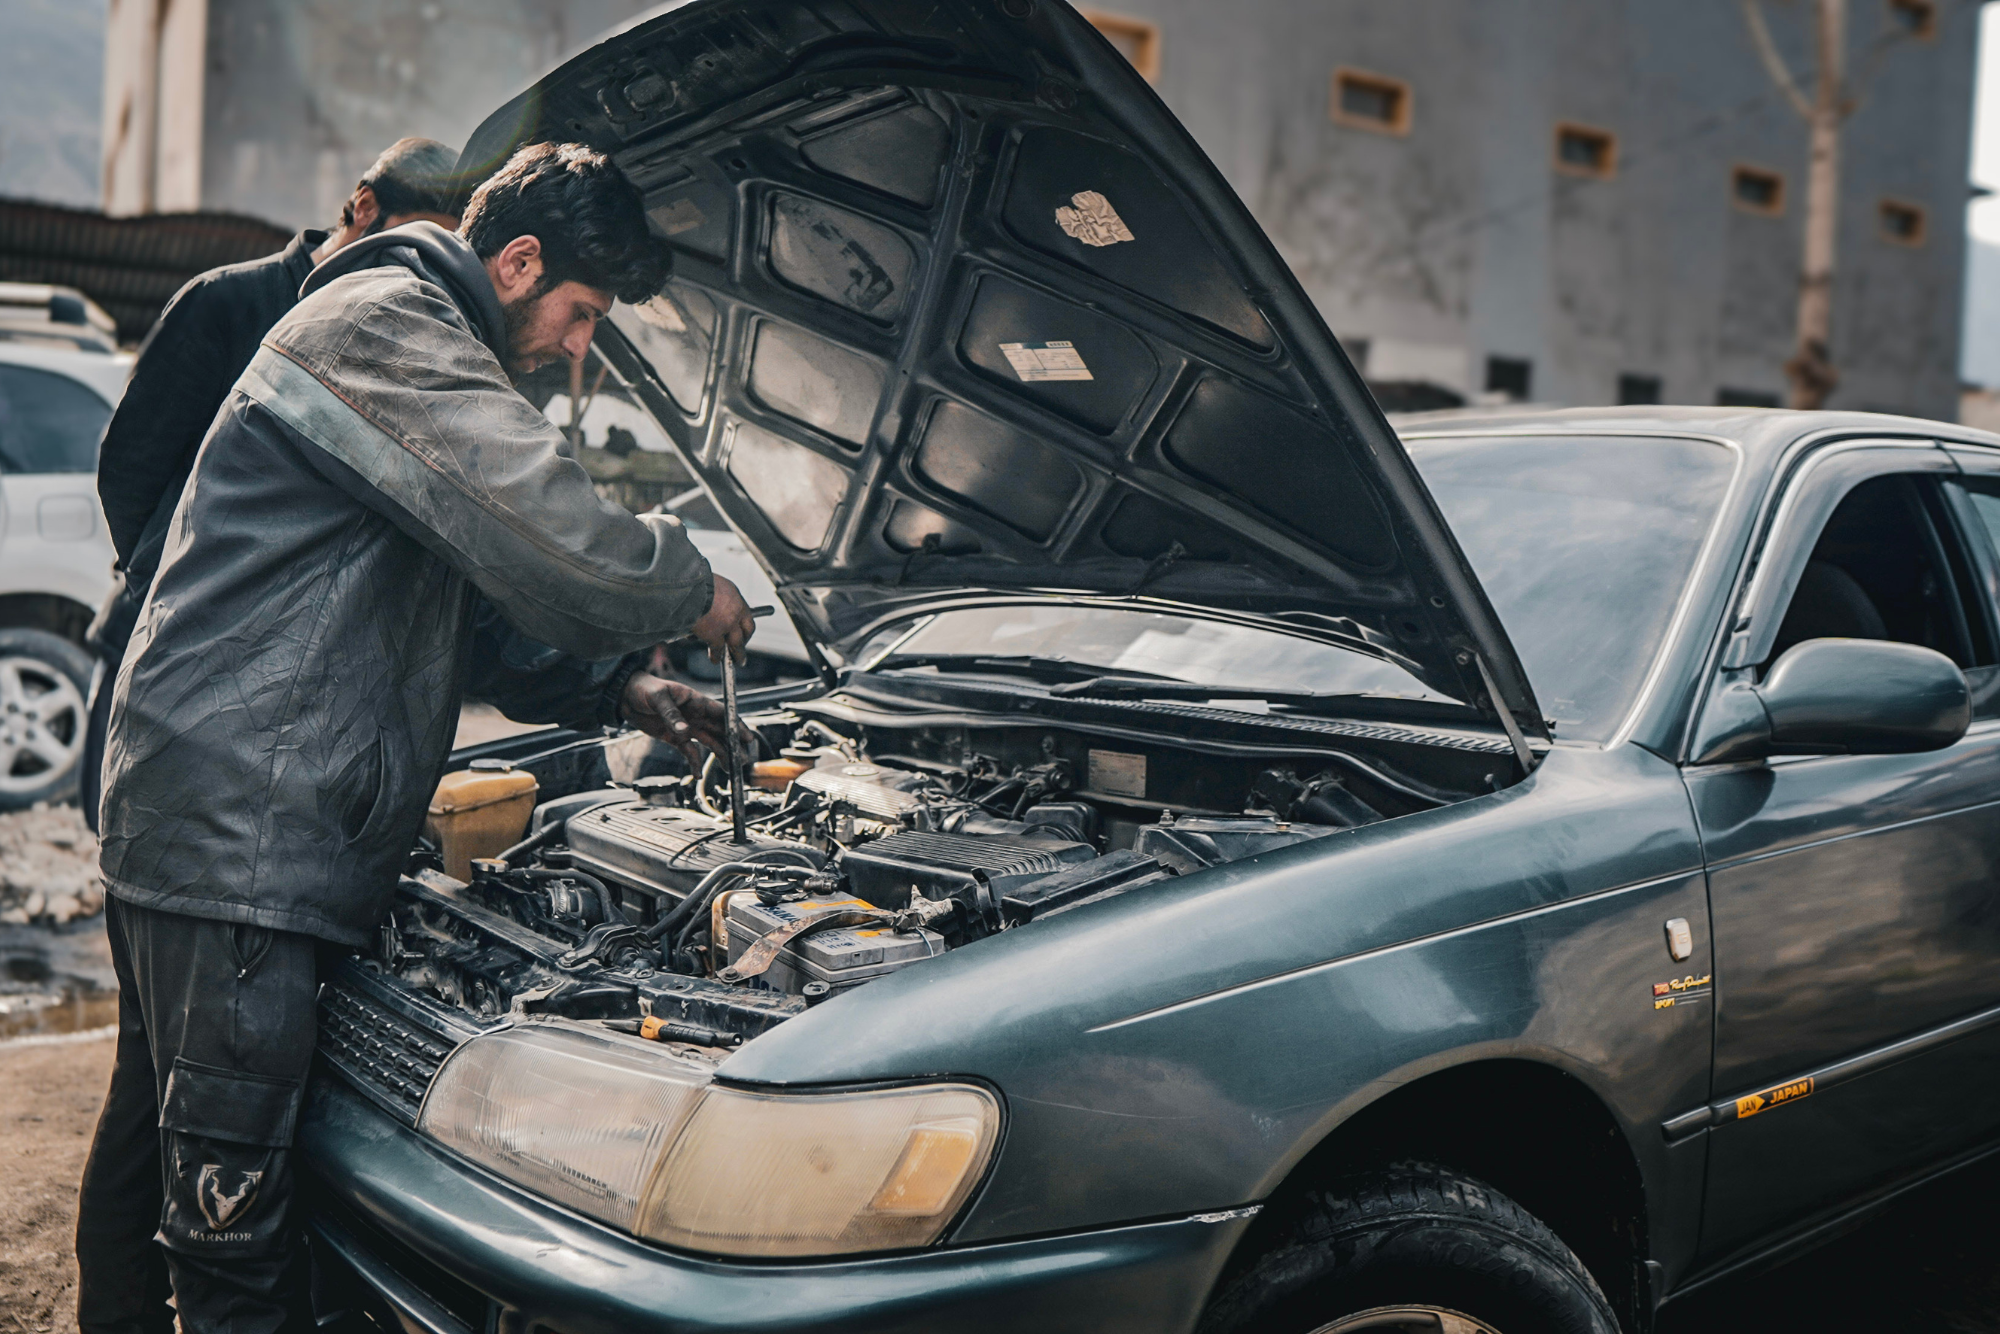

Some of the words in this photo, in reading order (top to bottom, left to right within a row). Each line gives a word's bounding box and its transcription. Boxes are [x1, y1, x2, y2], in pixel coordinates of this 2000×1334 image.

[1741, 1098, 1757, 1114] JAN
[1770, 1081, 1808, 1104] JAPAN
[187, 1229, 252, 1242] MARKHOR
